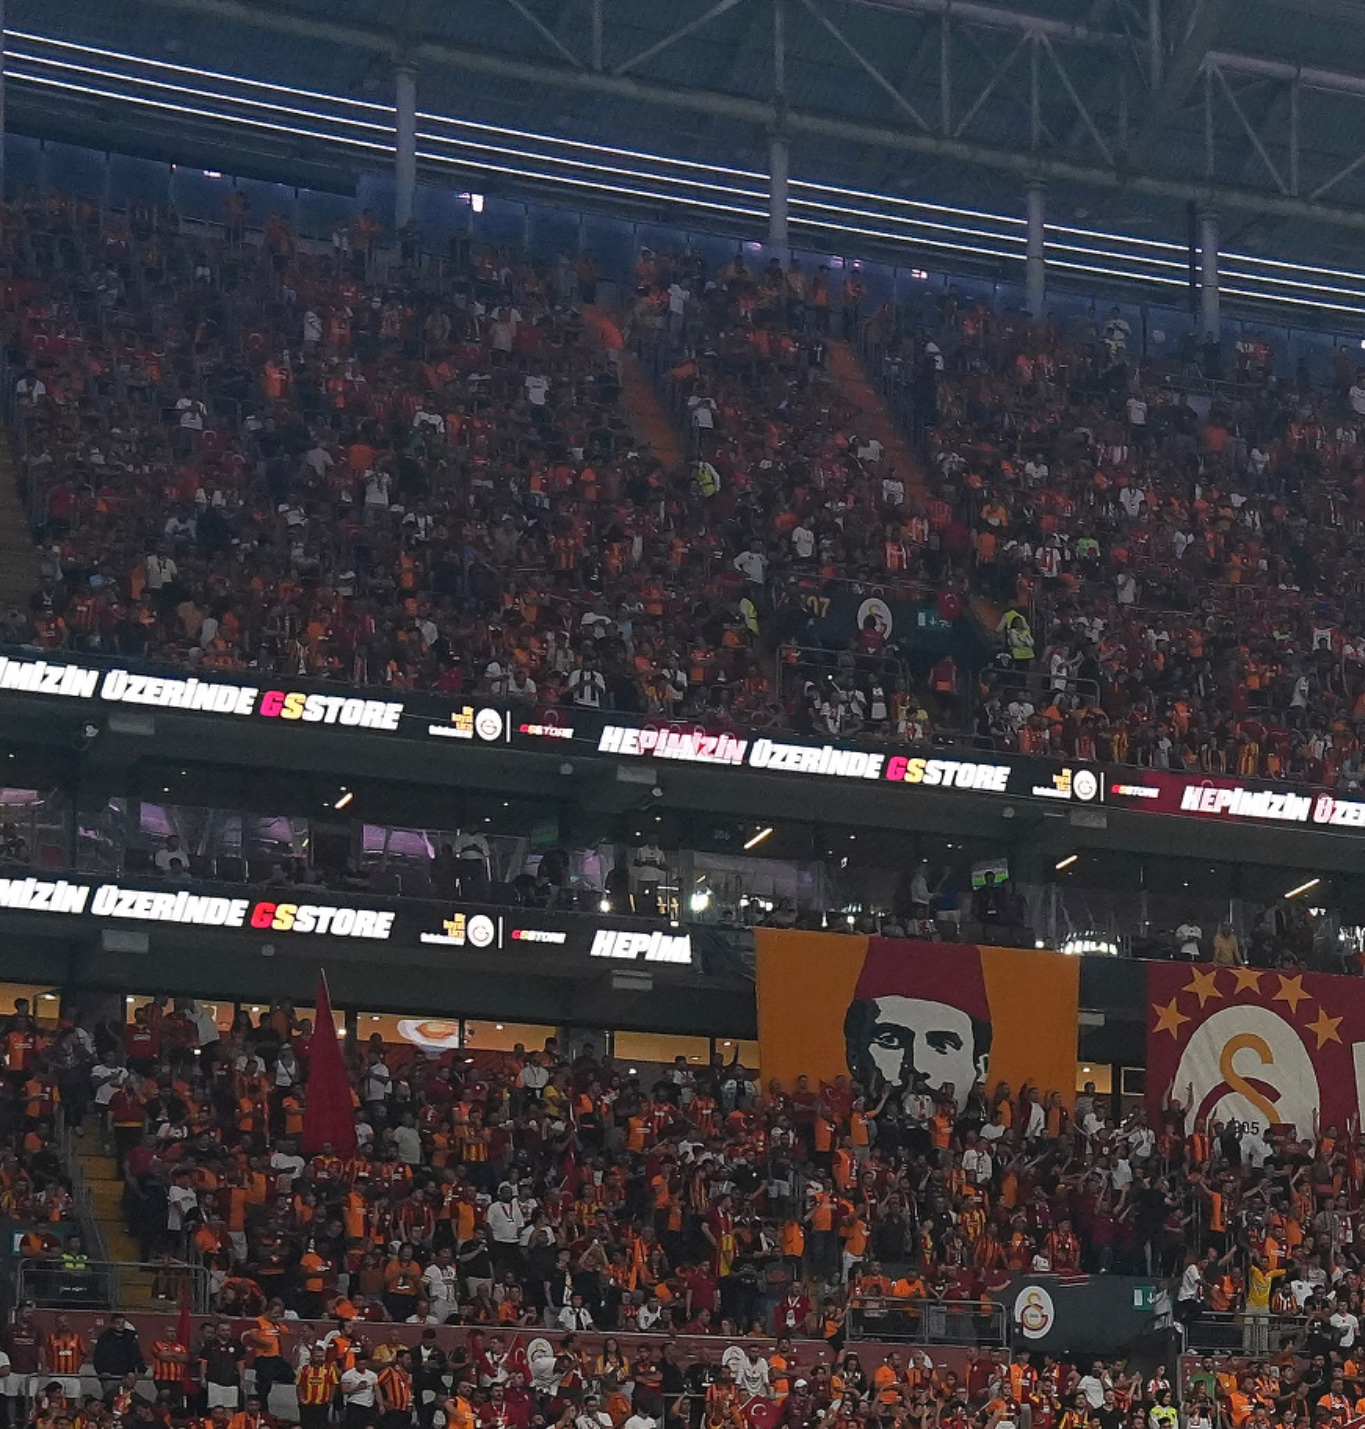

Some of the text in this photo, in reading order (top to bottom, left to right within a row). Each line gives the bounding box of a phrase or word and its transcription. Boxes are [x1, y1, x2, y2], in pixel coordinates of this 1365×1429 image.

[101, 669, 258, 715] ÜZERİNDE
[259, 690, 404, 731] GSSTORE
[598, 725, 748, 765] HEPİMİZİN
[749, 738, 885, 780] ÜZERİNDE
[886, 756, 1011, 792] GSSTORE
[1180, 786, 1312, 822] HEPİMİZİN
[91, 884, 250, 927] ÜZERİNDE
[250, 901, 396, 939] GSSTORE
